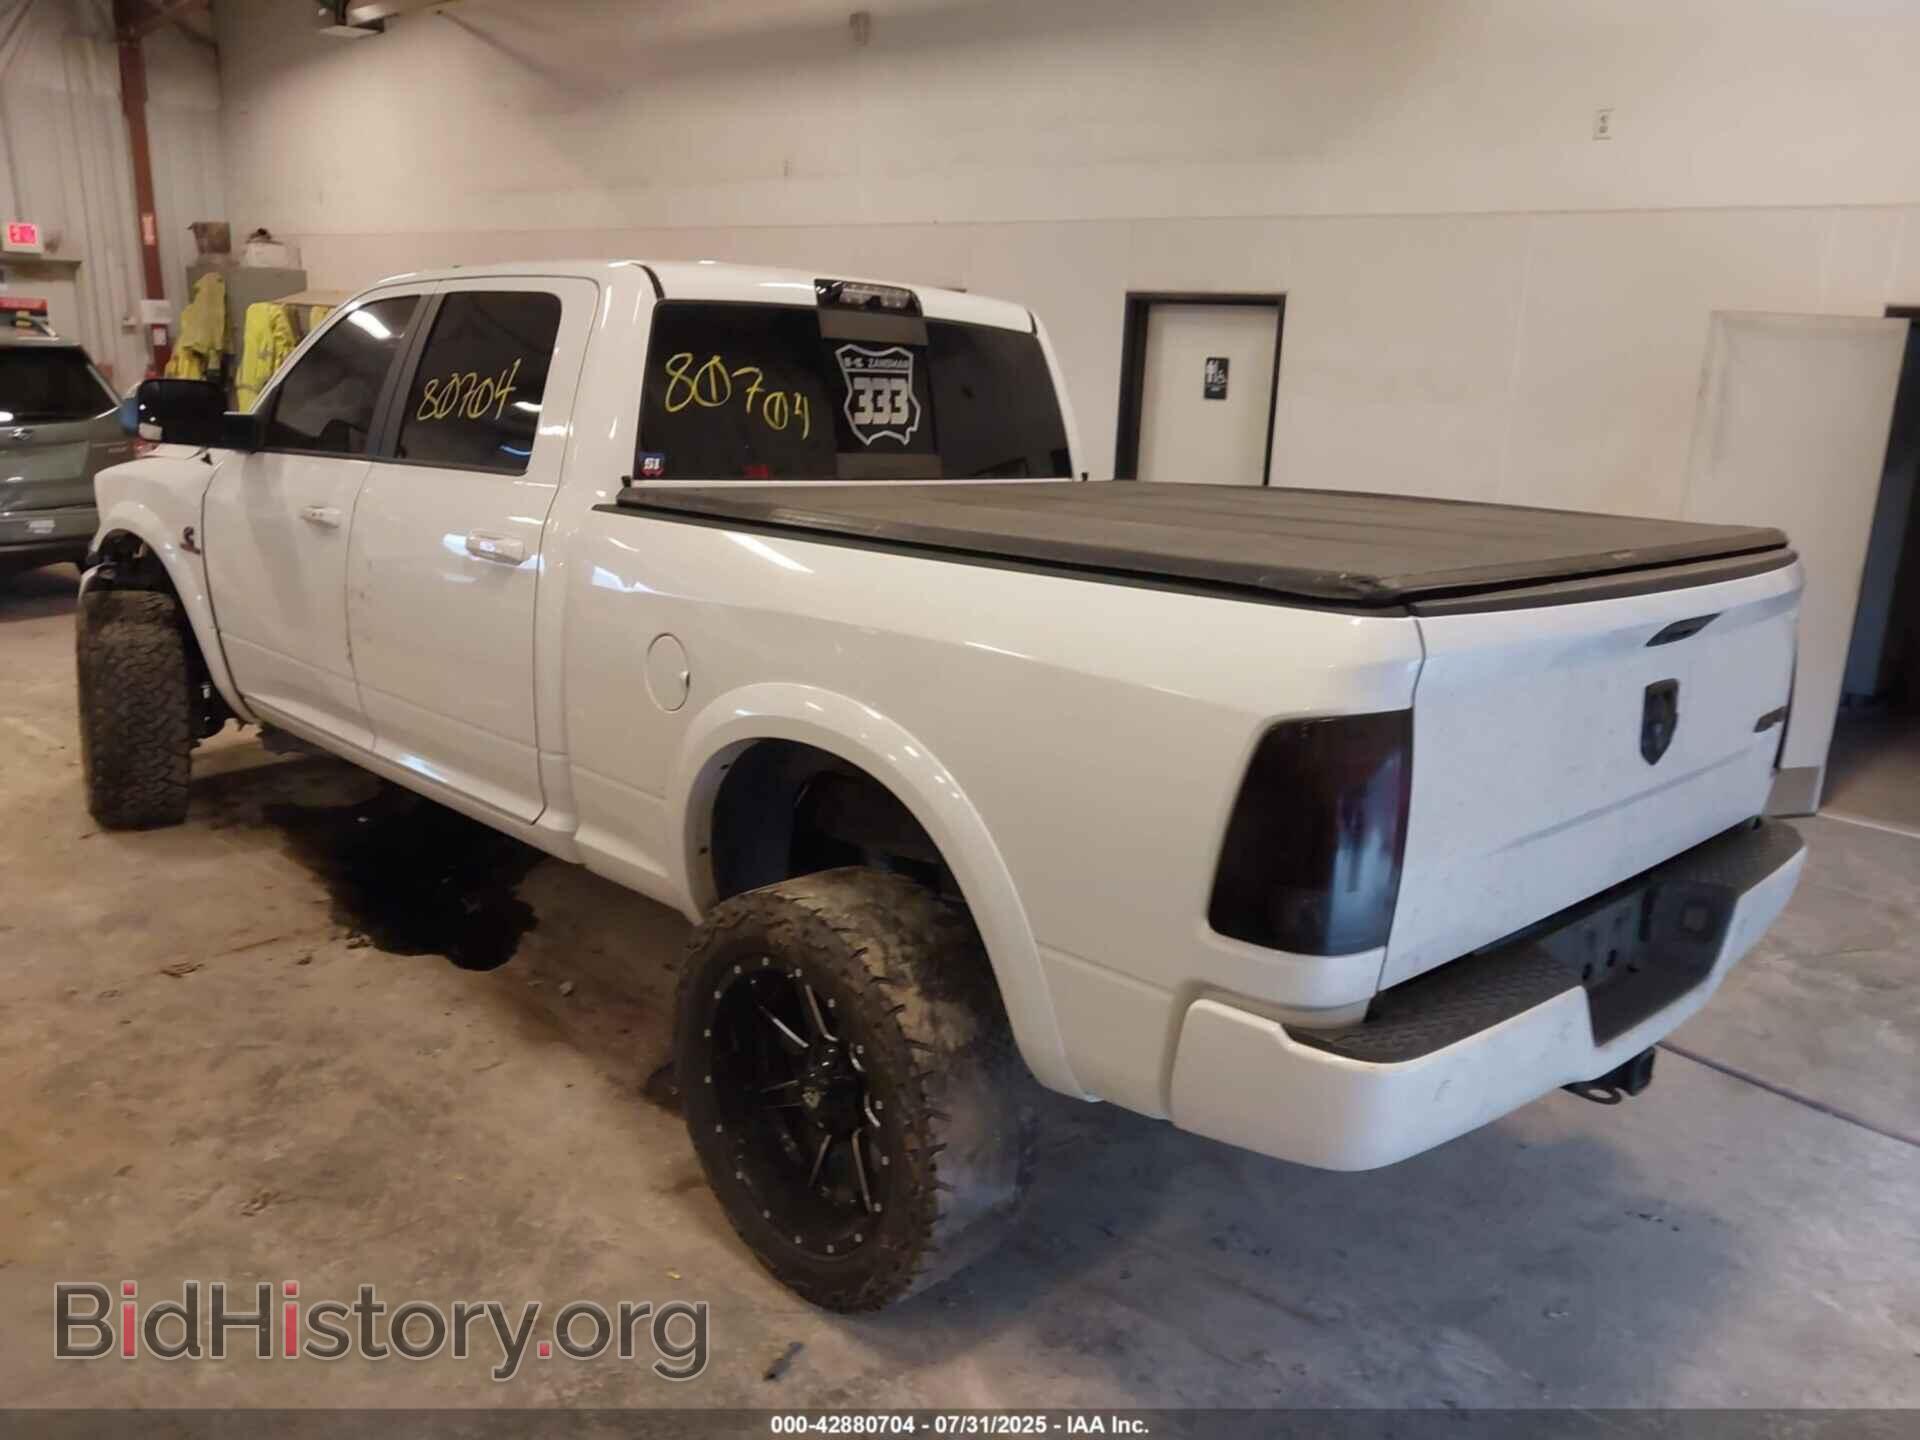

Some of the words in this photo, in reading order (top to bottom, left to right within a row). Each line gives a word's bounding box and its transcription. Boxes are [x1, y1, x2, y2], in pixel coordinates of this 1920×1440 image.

[416, 358, 521, 421] 80704
[664, 352, 810, 440] 80704
[851, 377, 909, 425] 333
